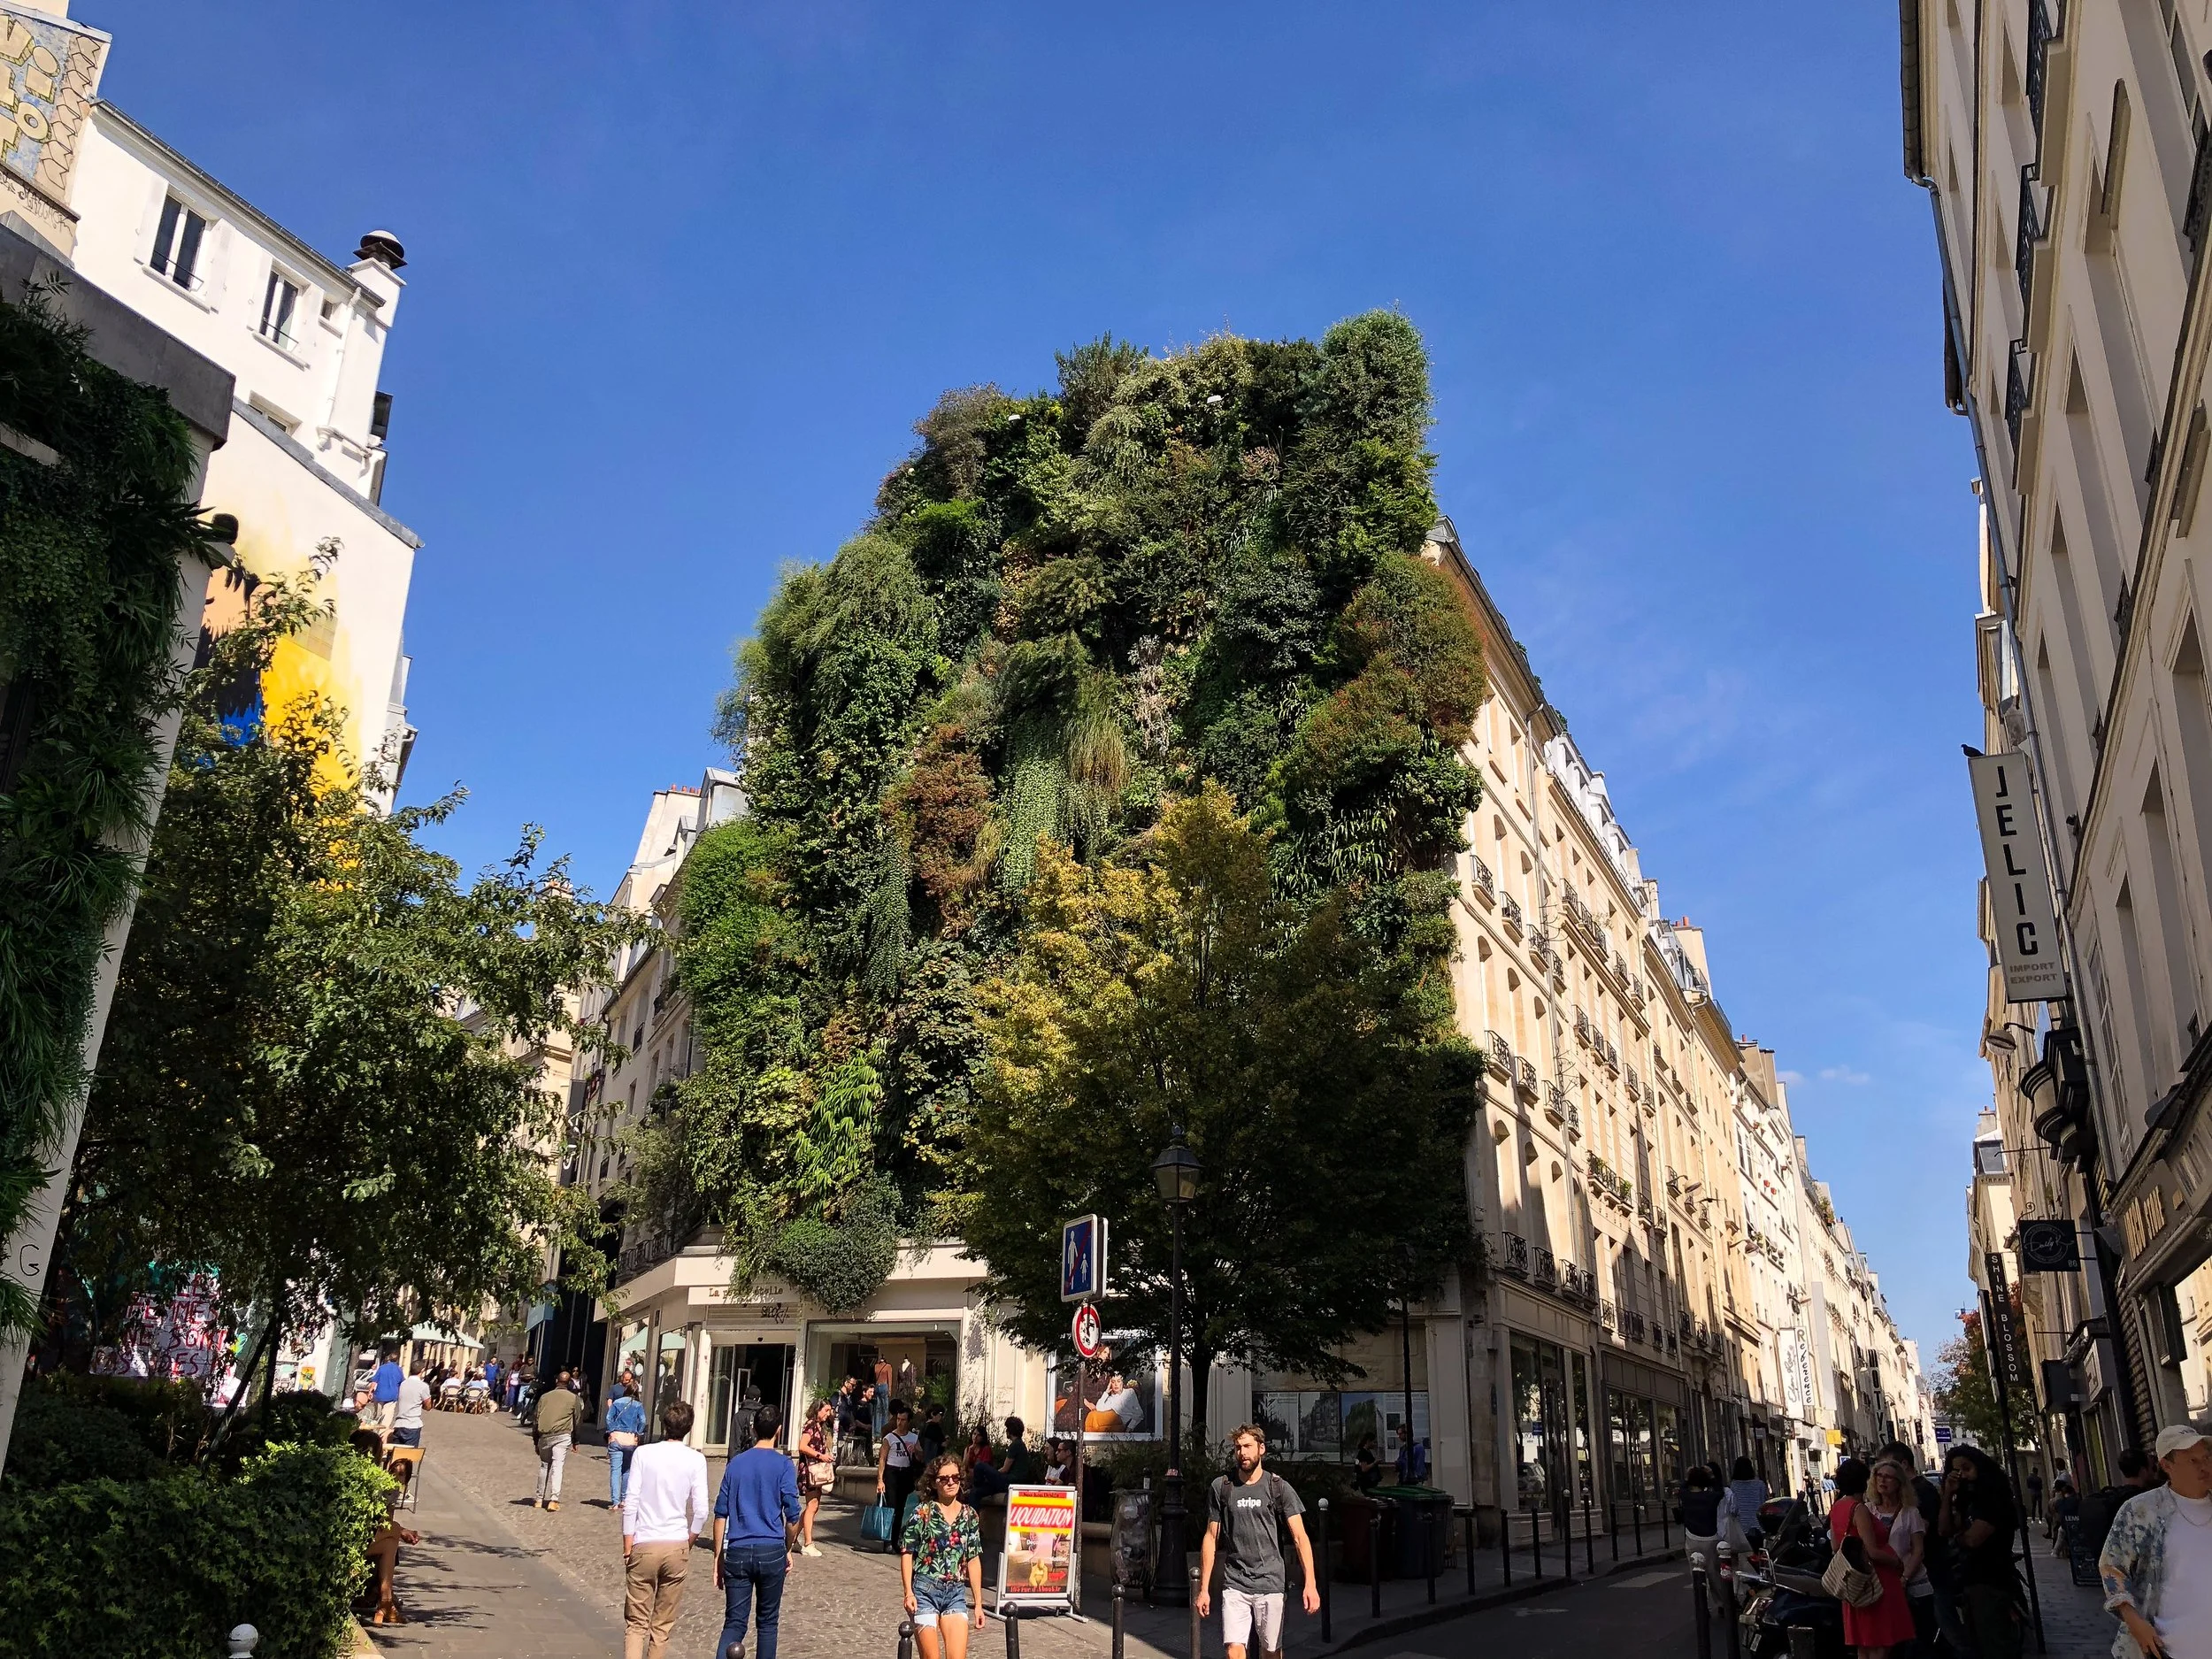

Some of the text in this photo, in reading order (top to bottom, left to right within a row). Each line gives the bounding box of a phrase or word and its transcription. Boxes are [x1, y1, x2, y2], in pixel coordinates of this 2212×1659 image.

[1995, 765, 2039, 956] JELIC
[2009, 961, 2055, 973] IMPORT
[2009, 972, 2058, 985] EXPORT
[19, 1243, 41, 1277] G
[1991, 1255, 2005, 1303] SHINE
[709, 1287, 720, 1297] La
[2001, 1314, 2018, 1383] BLOSSOM
[1236, 1496, 1262, 1509] stripe
[1010, 1506, 1073, 1527] LIQUIDATION
